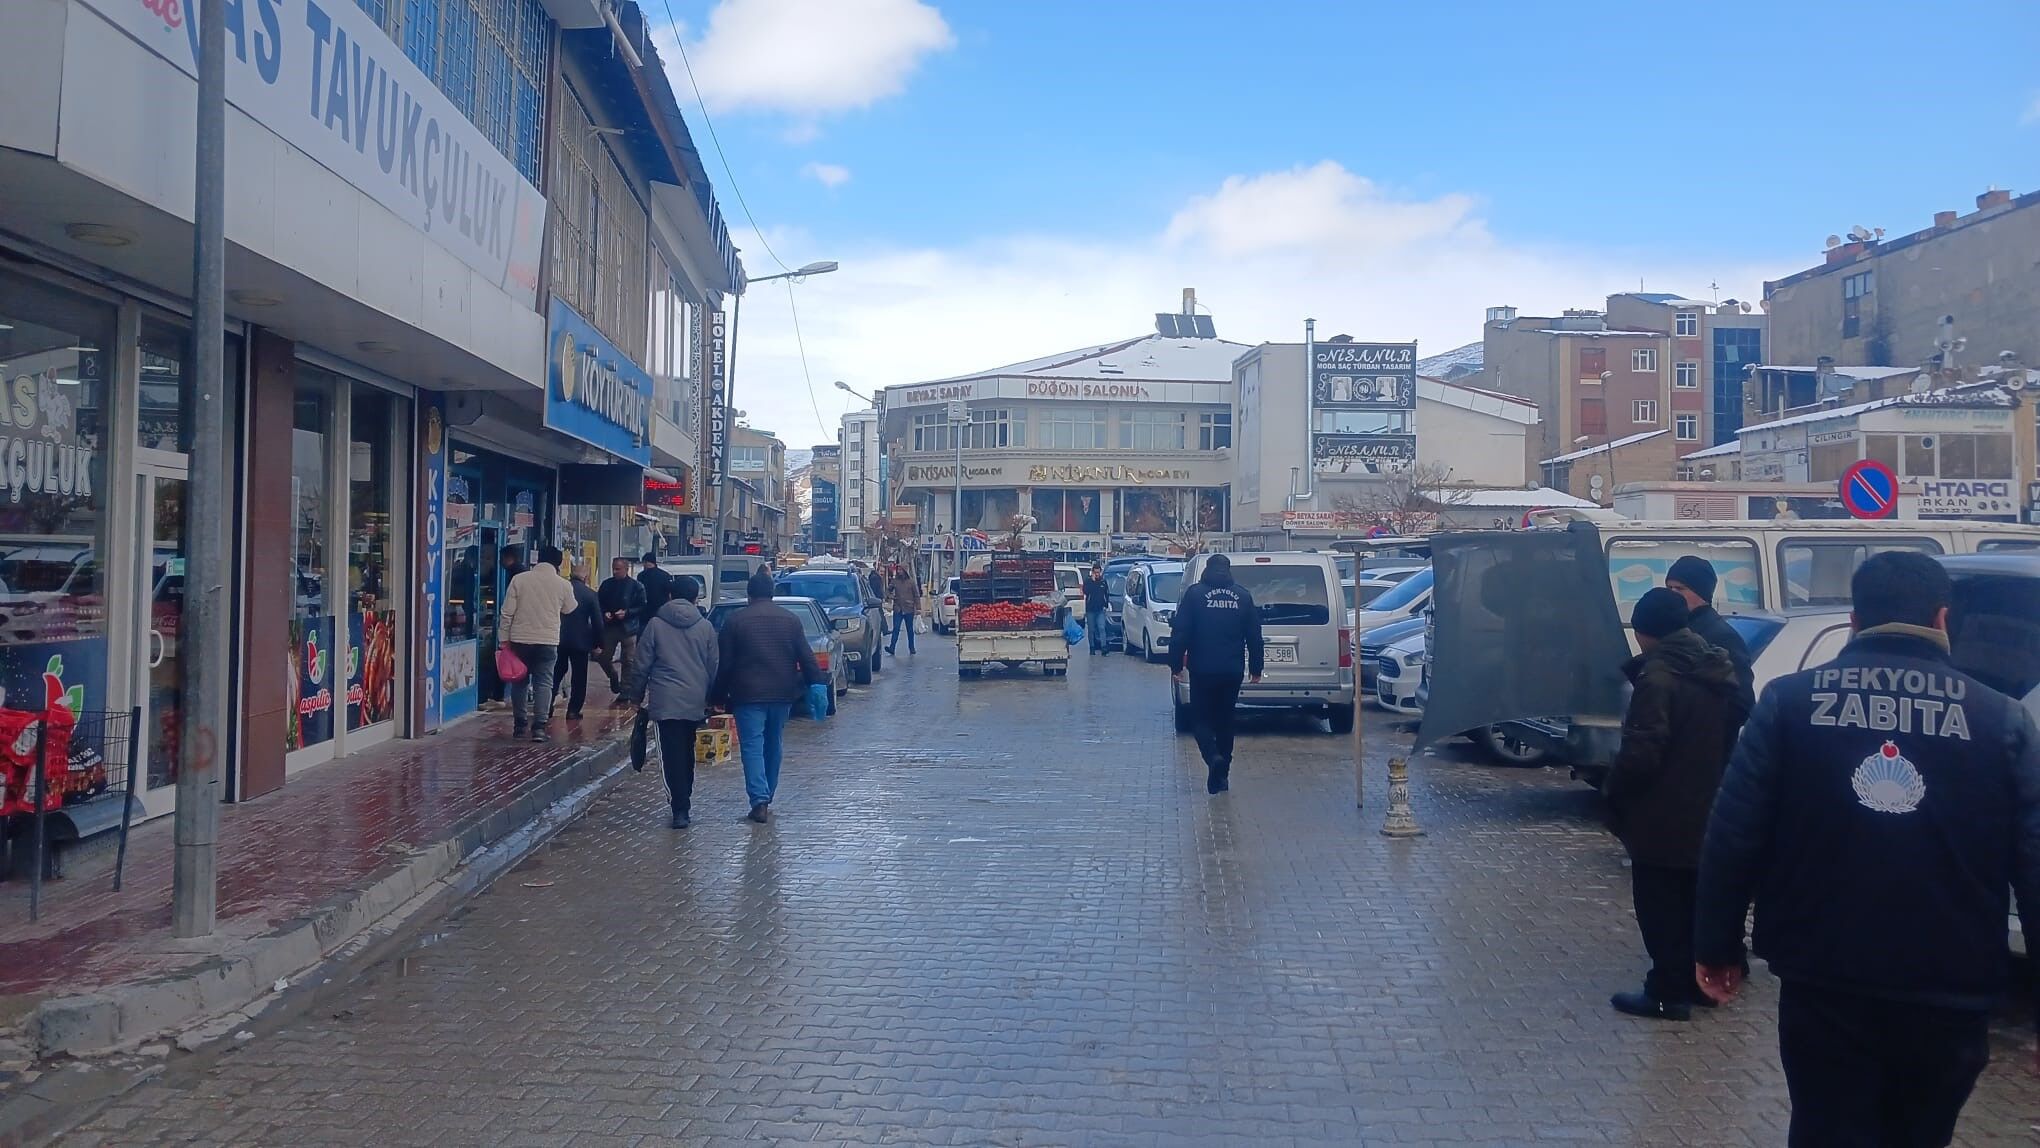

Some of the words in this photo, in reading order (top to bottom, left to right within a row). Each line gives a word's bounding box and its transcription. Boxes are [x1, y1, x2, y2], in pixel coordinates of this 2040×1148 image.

[306, 0, 506, 255] TAVUKÇULUK
[712, 312, 724, 376] HOTEL
[1028, 381, 1079, 397] DÜĞÜN
[1083, 384, 1139, 398] SALONU
[711, 394, 724, 486] AKDENİZ
[1206, 599, 1239, 609] ZABITA
[1810, 693, 1971, 741] ZABITA
